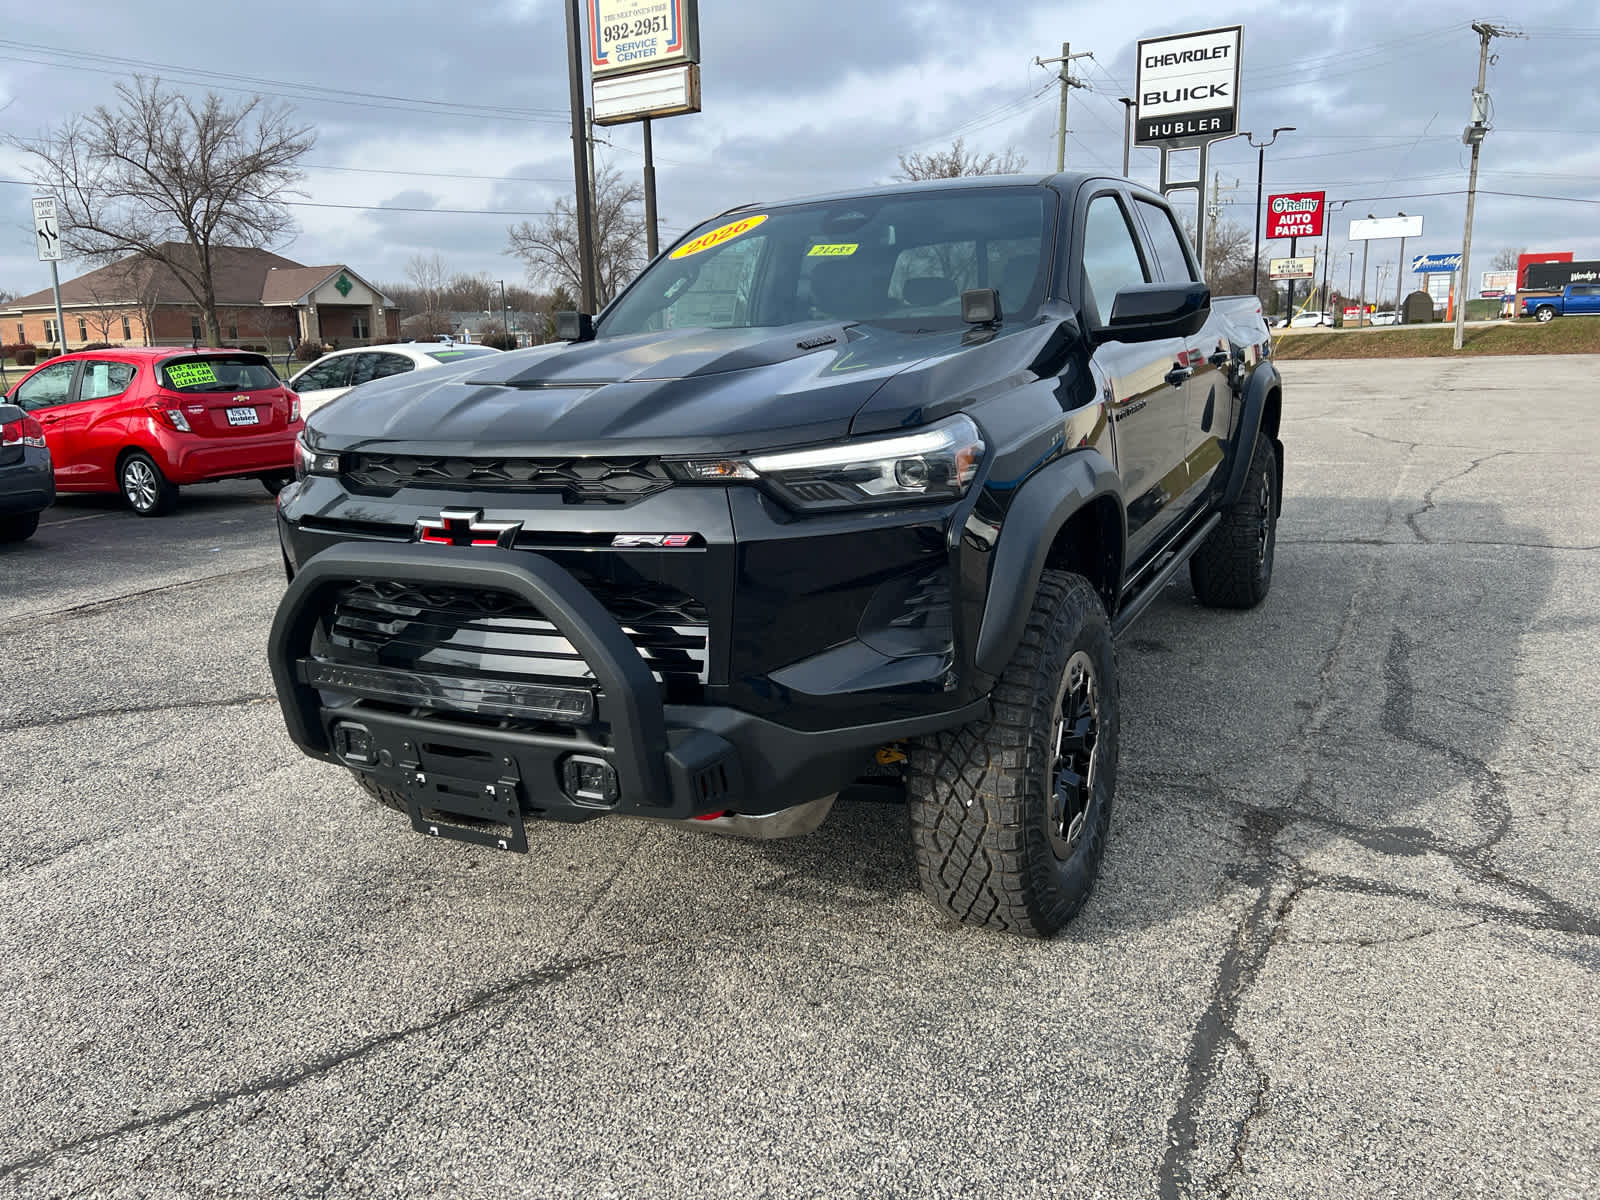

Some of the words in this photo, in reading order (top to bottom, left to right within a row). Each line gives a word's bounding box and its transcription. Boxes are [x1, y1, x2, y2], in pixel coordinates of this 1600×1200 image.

[603, 15, 668, 42] 932-2951
[615, 38, 657, 53] SERVICE
[616, 48, 657, 62] CENTER
[1145, 45, 1231, 68] CHEVROLET
[1143, 82, 1229, 106] BUICK
[1149, 118, 1220, 137] HUBLER
[35, 200, 53, 208] CENTER
[1272, 197, 1319, 213] O'Reilly
[38, 208, 52, 216] LANE
[1279, 213, 1311, 224] AUTO
[1275, 224, 1313, 236] PARTS
[686, 219, 751, 255] 2026
[43, 250, 56, 258] ONLY
[1570, 271, 1597, 281] Wendy's
[172, 371, 195, 379] LOCAL
[197, 369, 211, 377] CAR
[176, 376, 215, 386] CLEARANCE
[610, 534, 693, 547] ZR2
